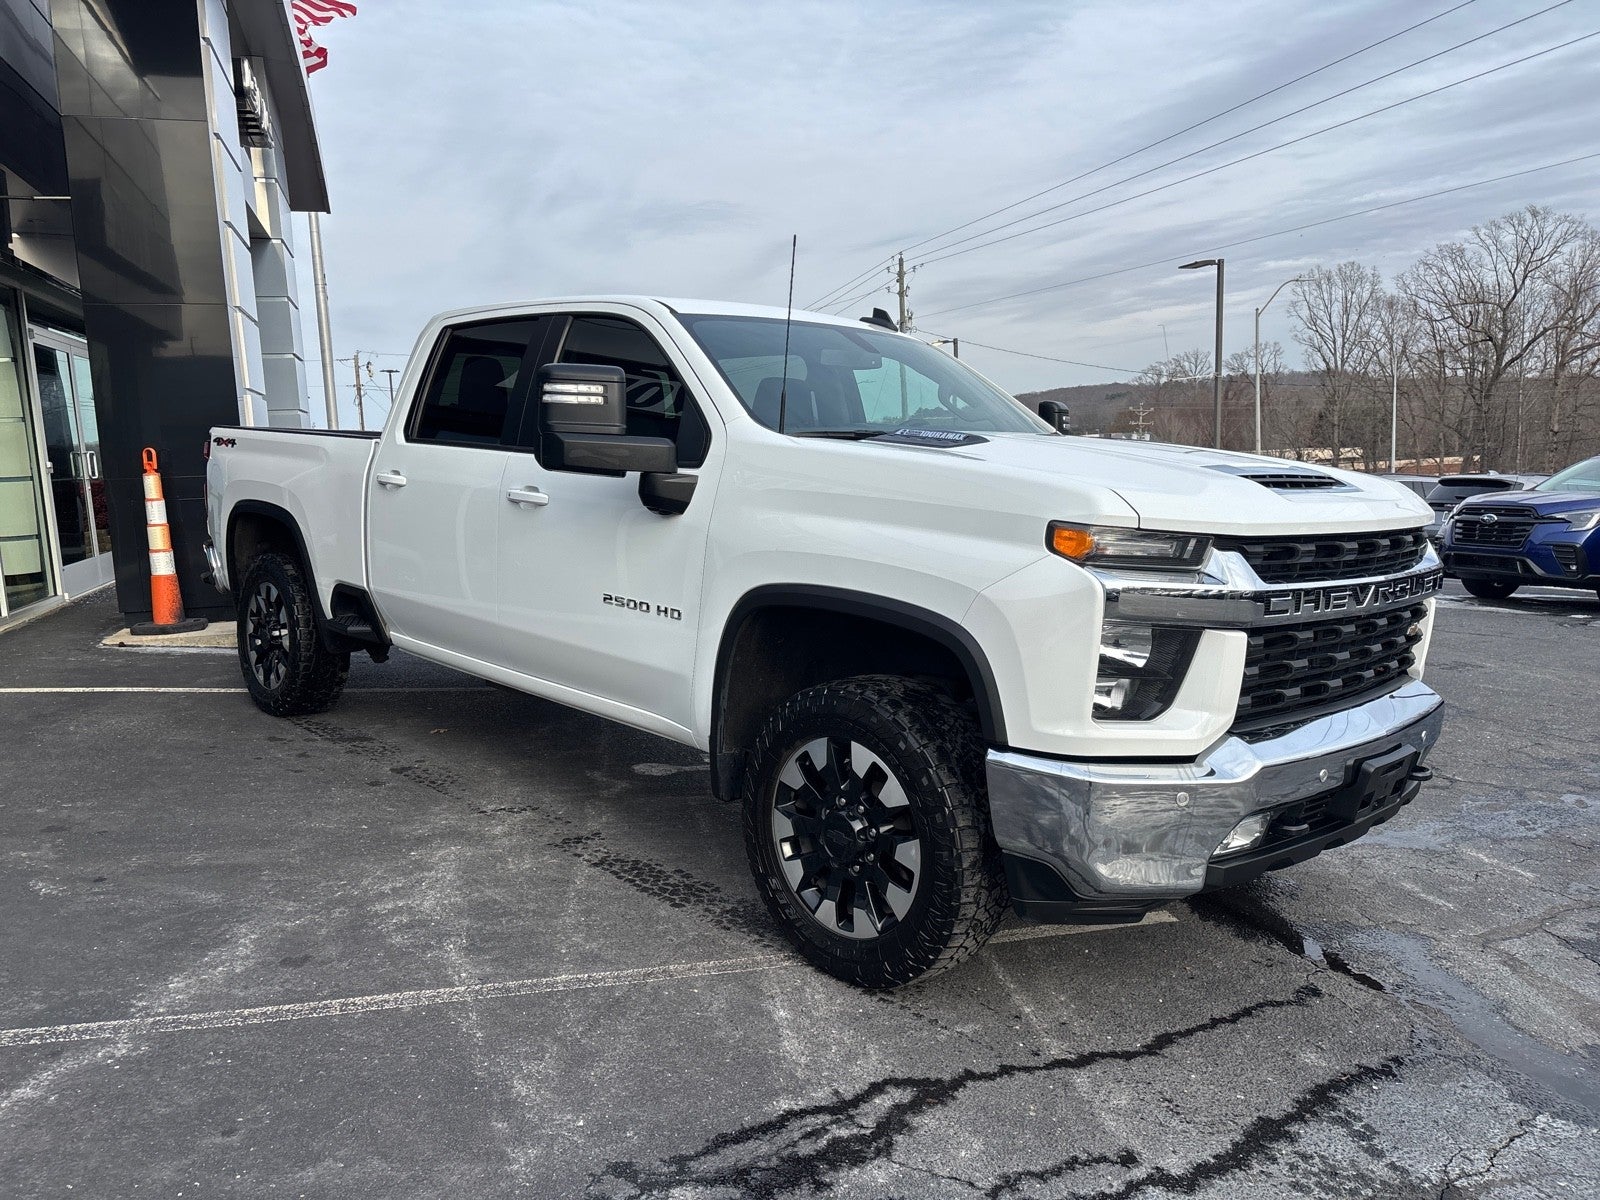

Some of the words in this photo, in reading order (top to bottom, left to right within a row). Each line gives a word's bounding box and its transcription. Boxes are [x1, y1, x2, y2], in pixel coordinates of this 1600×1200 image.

[603, 593, 650, 613] 2500
[657, 605, 682, 620] HD
[1263, 573, 1444, 618] CHEVROLET
